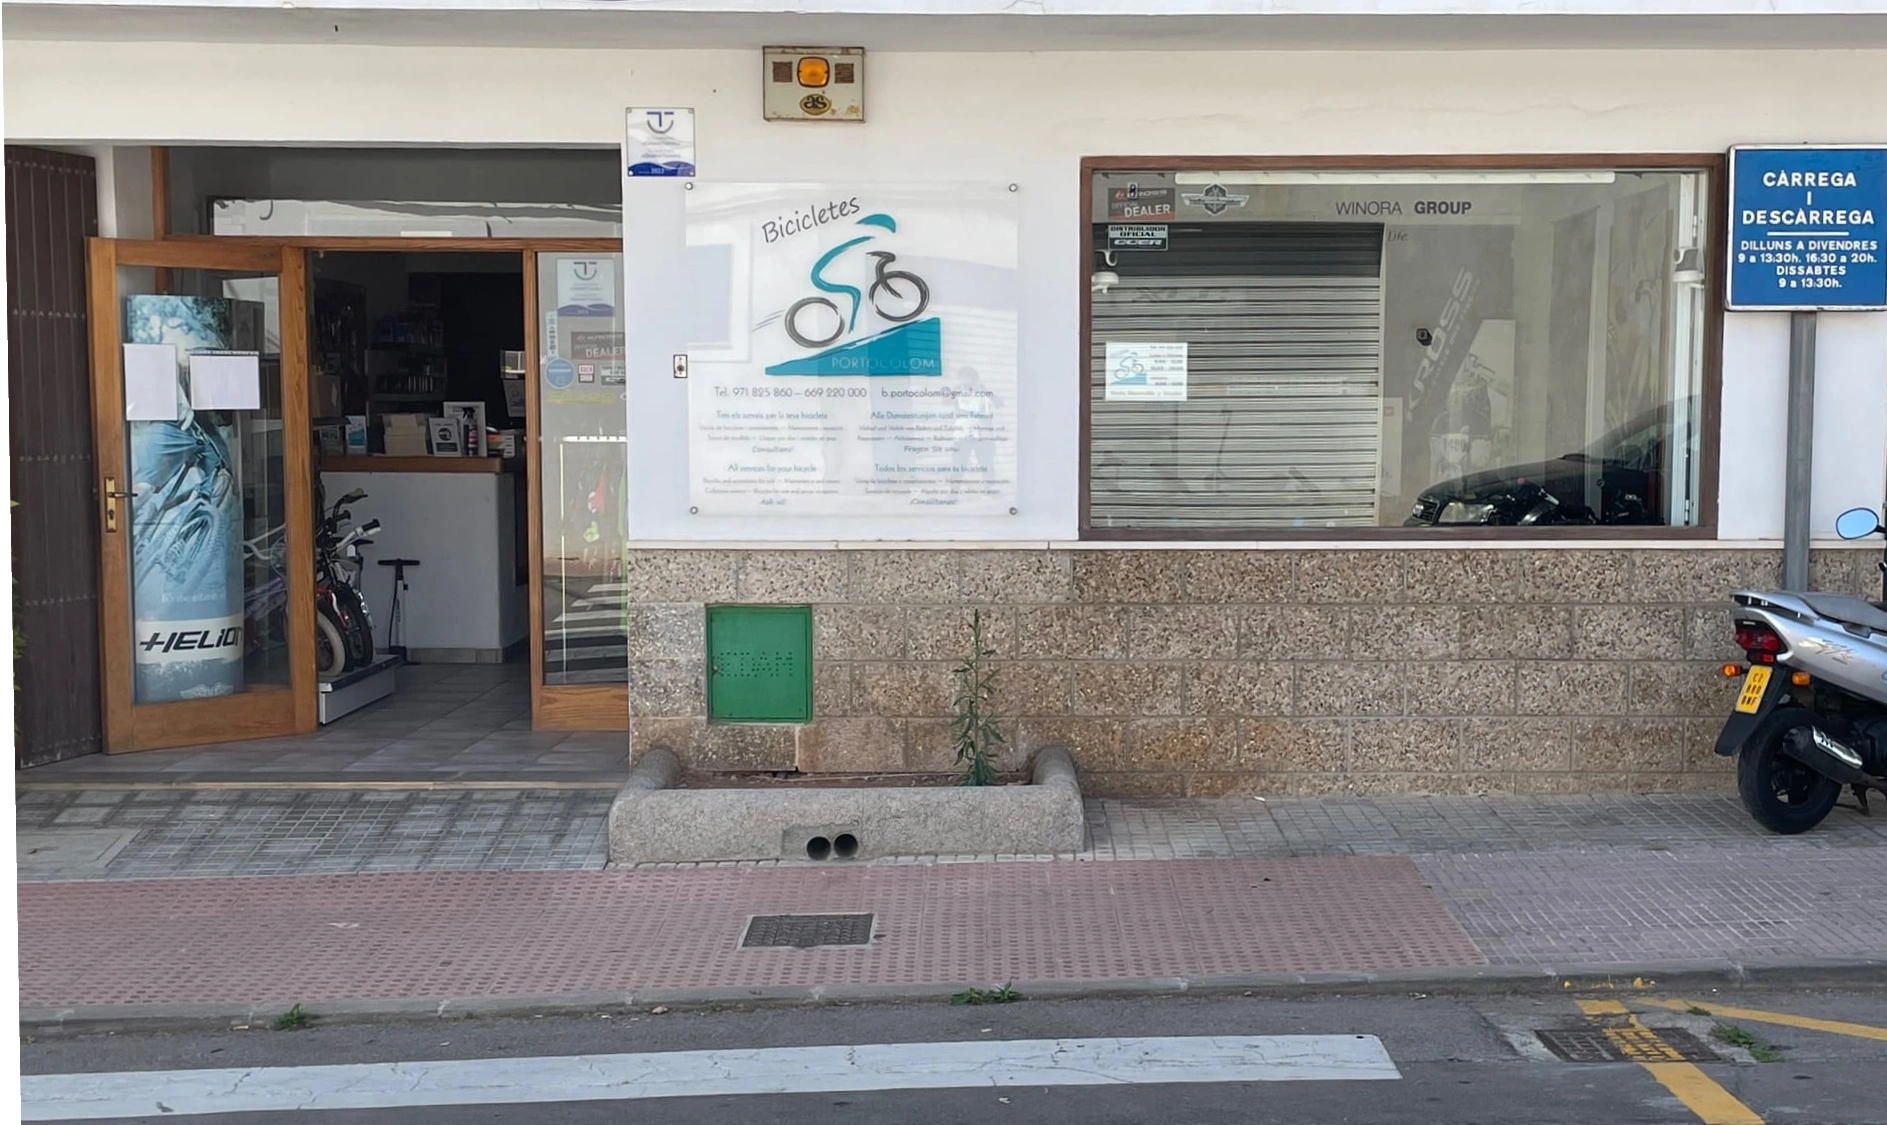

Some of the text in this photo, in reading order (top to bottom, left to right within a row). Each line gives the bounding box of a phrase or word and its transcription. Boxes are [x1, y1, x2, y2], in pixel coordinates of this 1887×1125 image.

[1762, 169, 1857, 187] CÀRREGA
[1806, 191, 1812, 205] I
[1124, 203, 1171, 218] DEALER
[1335, 200, 1472, 215] WINORA GROUP
[761, 196, 861, 243] Bicicletes
[1742, 208, 1875, 225] DESCÀRREGA
[1741, 240, 1878, 251] DILLUNS A DIVENDRES
[1738, 253, 1745, 263] 9
[1749, 255, 1757, 263] a
[1806, 253, 1836, 263] 16:30
[1840, 255, 1847, 263] a
[1851, 253, 1878, 263] 20h.
[1776, 265, 1847, 276] DISSABTES
[1779, 278, 1786, 288] 9
[1790, 280, 1797, 288] a
[1406, 266, 1473, 421] KROSS
[714, 386, 729, 397] Tel.
[732, 387, 749, 397] 971
[751, 387, 771, 397] 825
[772, 387, 793, 397] 860
[804, 387, 823, 397] 669
[826, 387, 845, 397] 220
[847, 387, 867, 397] 000
